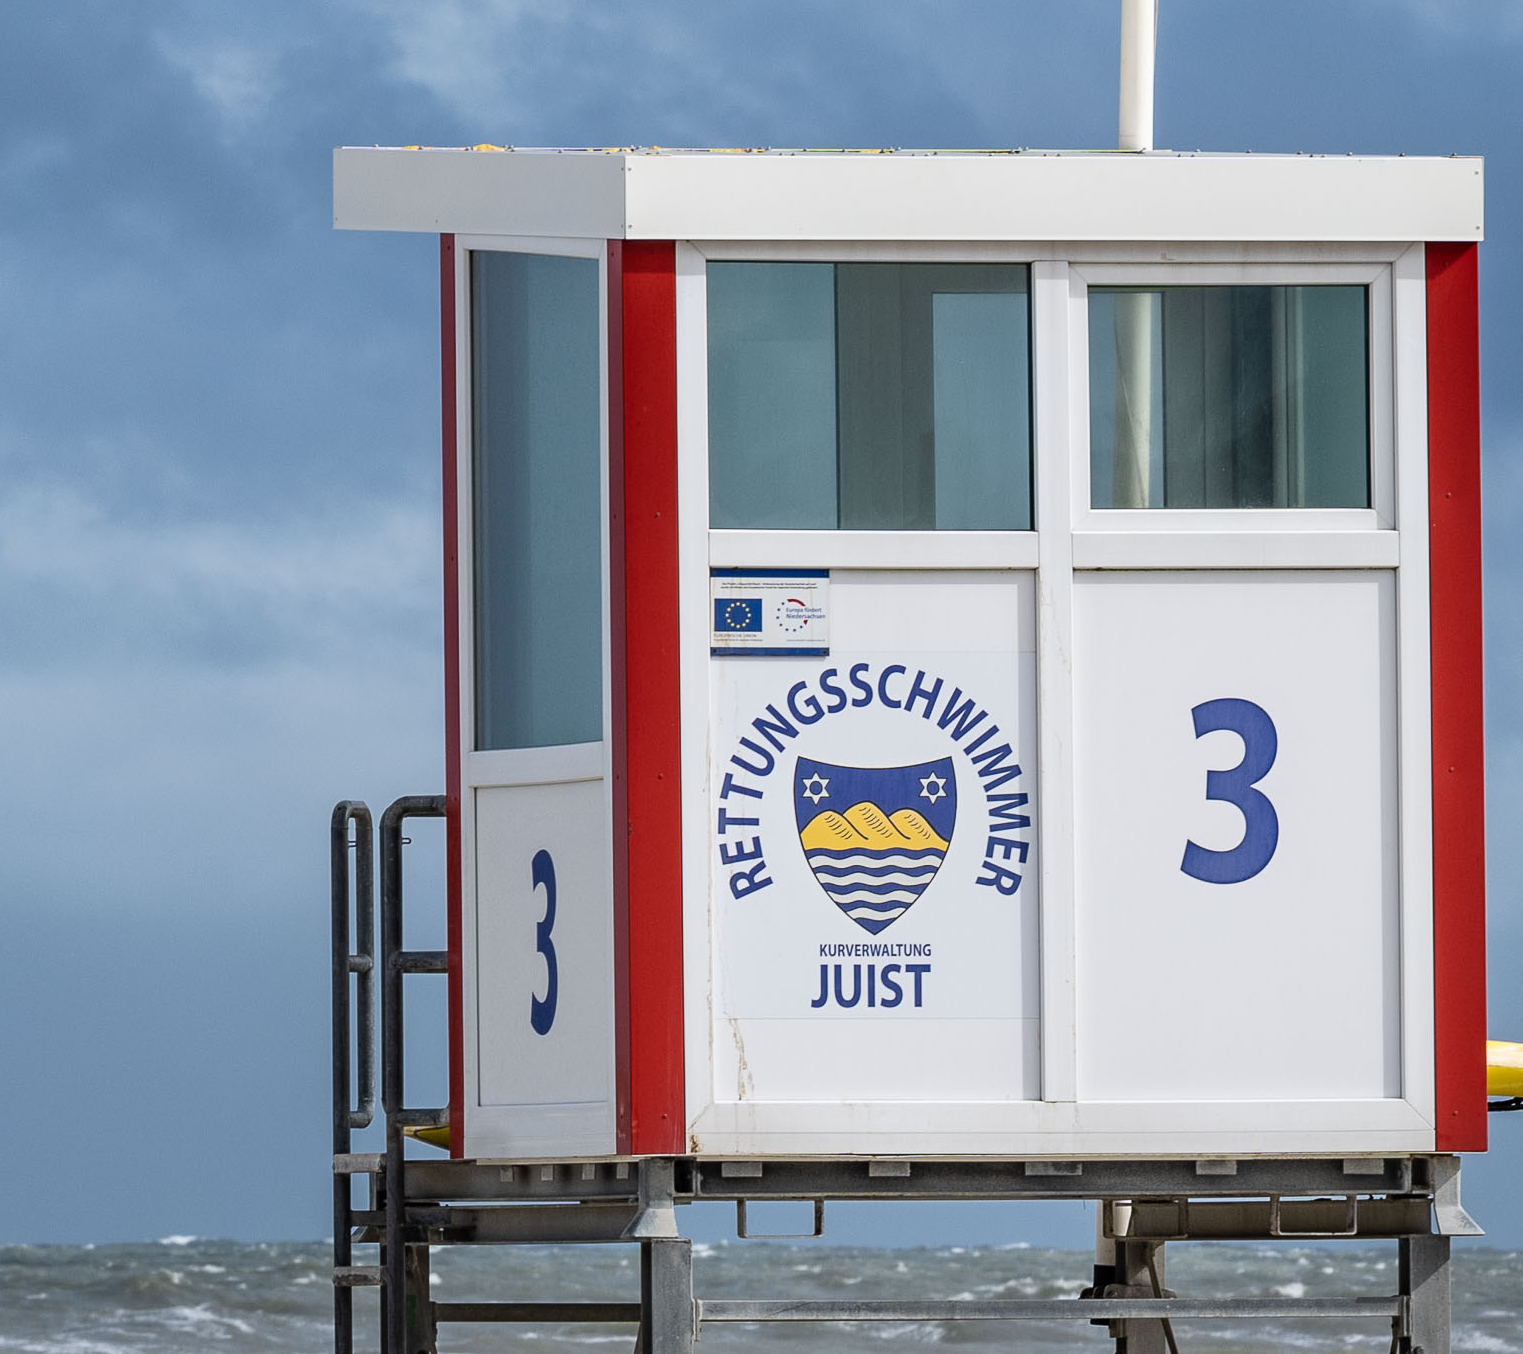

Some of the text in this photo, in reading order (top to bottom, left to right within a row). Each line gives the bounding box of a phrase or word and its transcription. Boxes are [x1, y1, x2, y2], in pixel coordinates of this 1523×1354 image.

[718, 662, 1032, 900] RETTUNGSSCHWIMMER
[1180, 697, 1279, 885] 3
[530, 849, 558, 1036] 3
[810, 963, 932, 1008] JUIST
[819, 943, 932, 957] KURVERWALTUNG
